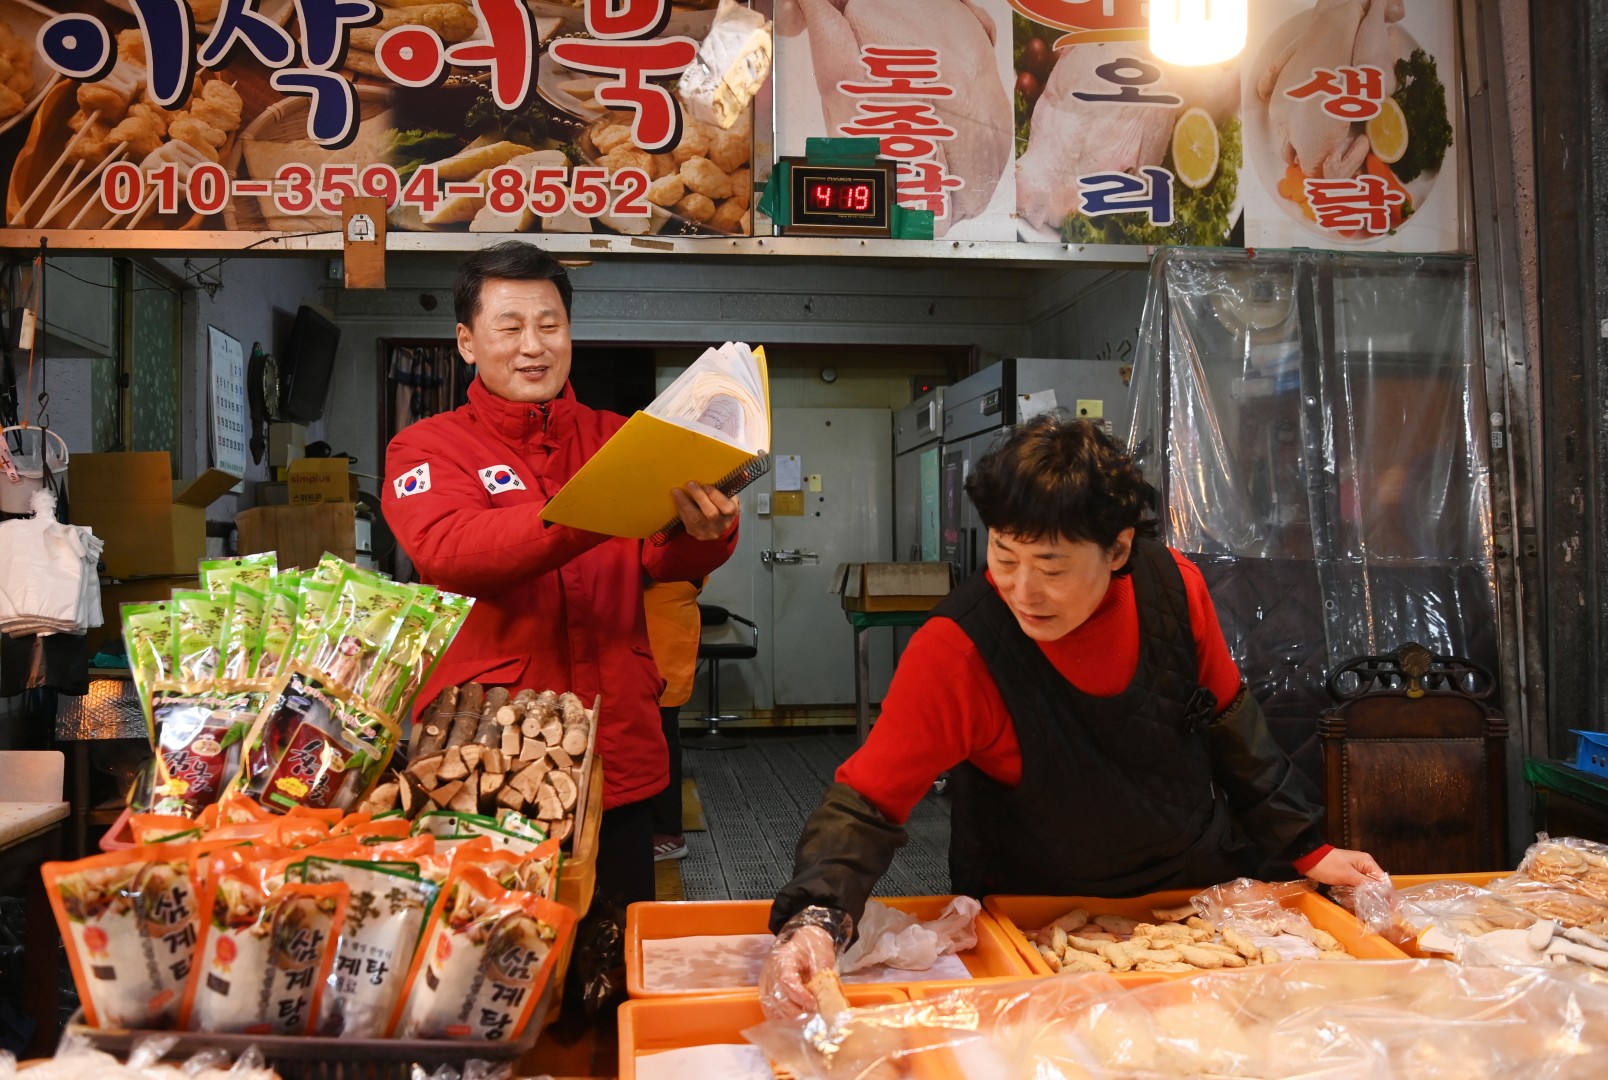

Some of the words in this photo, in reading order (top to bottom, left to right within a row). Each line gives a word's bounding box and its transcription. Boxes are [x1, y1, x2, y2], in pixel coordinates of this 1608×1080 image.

[101, 161, 652, 218] 010-3594-8552
[1284, 65, 1405, 232] 생닭
[278, 927, 324, 1027] 삼계탕
[479, 945, 539, 1040] 삼계탕
